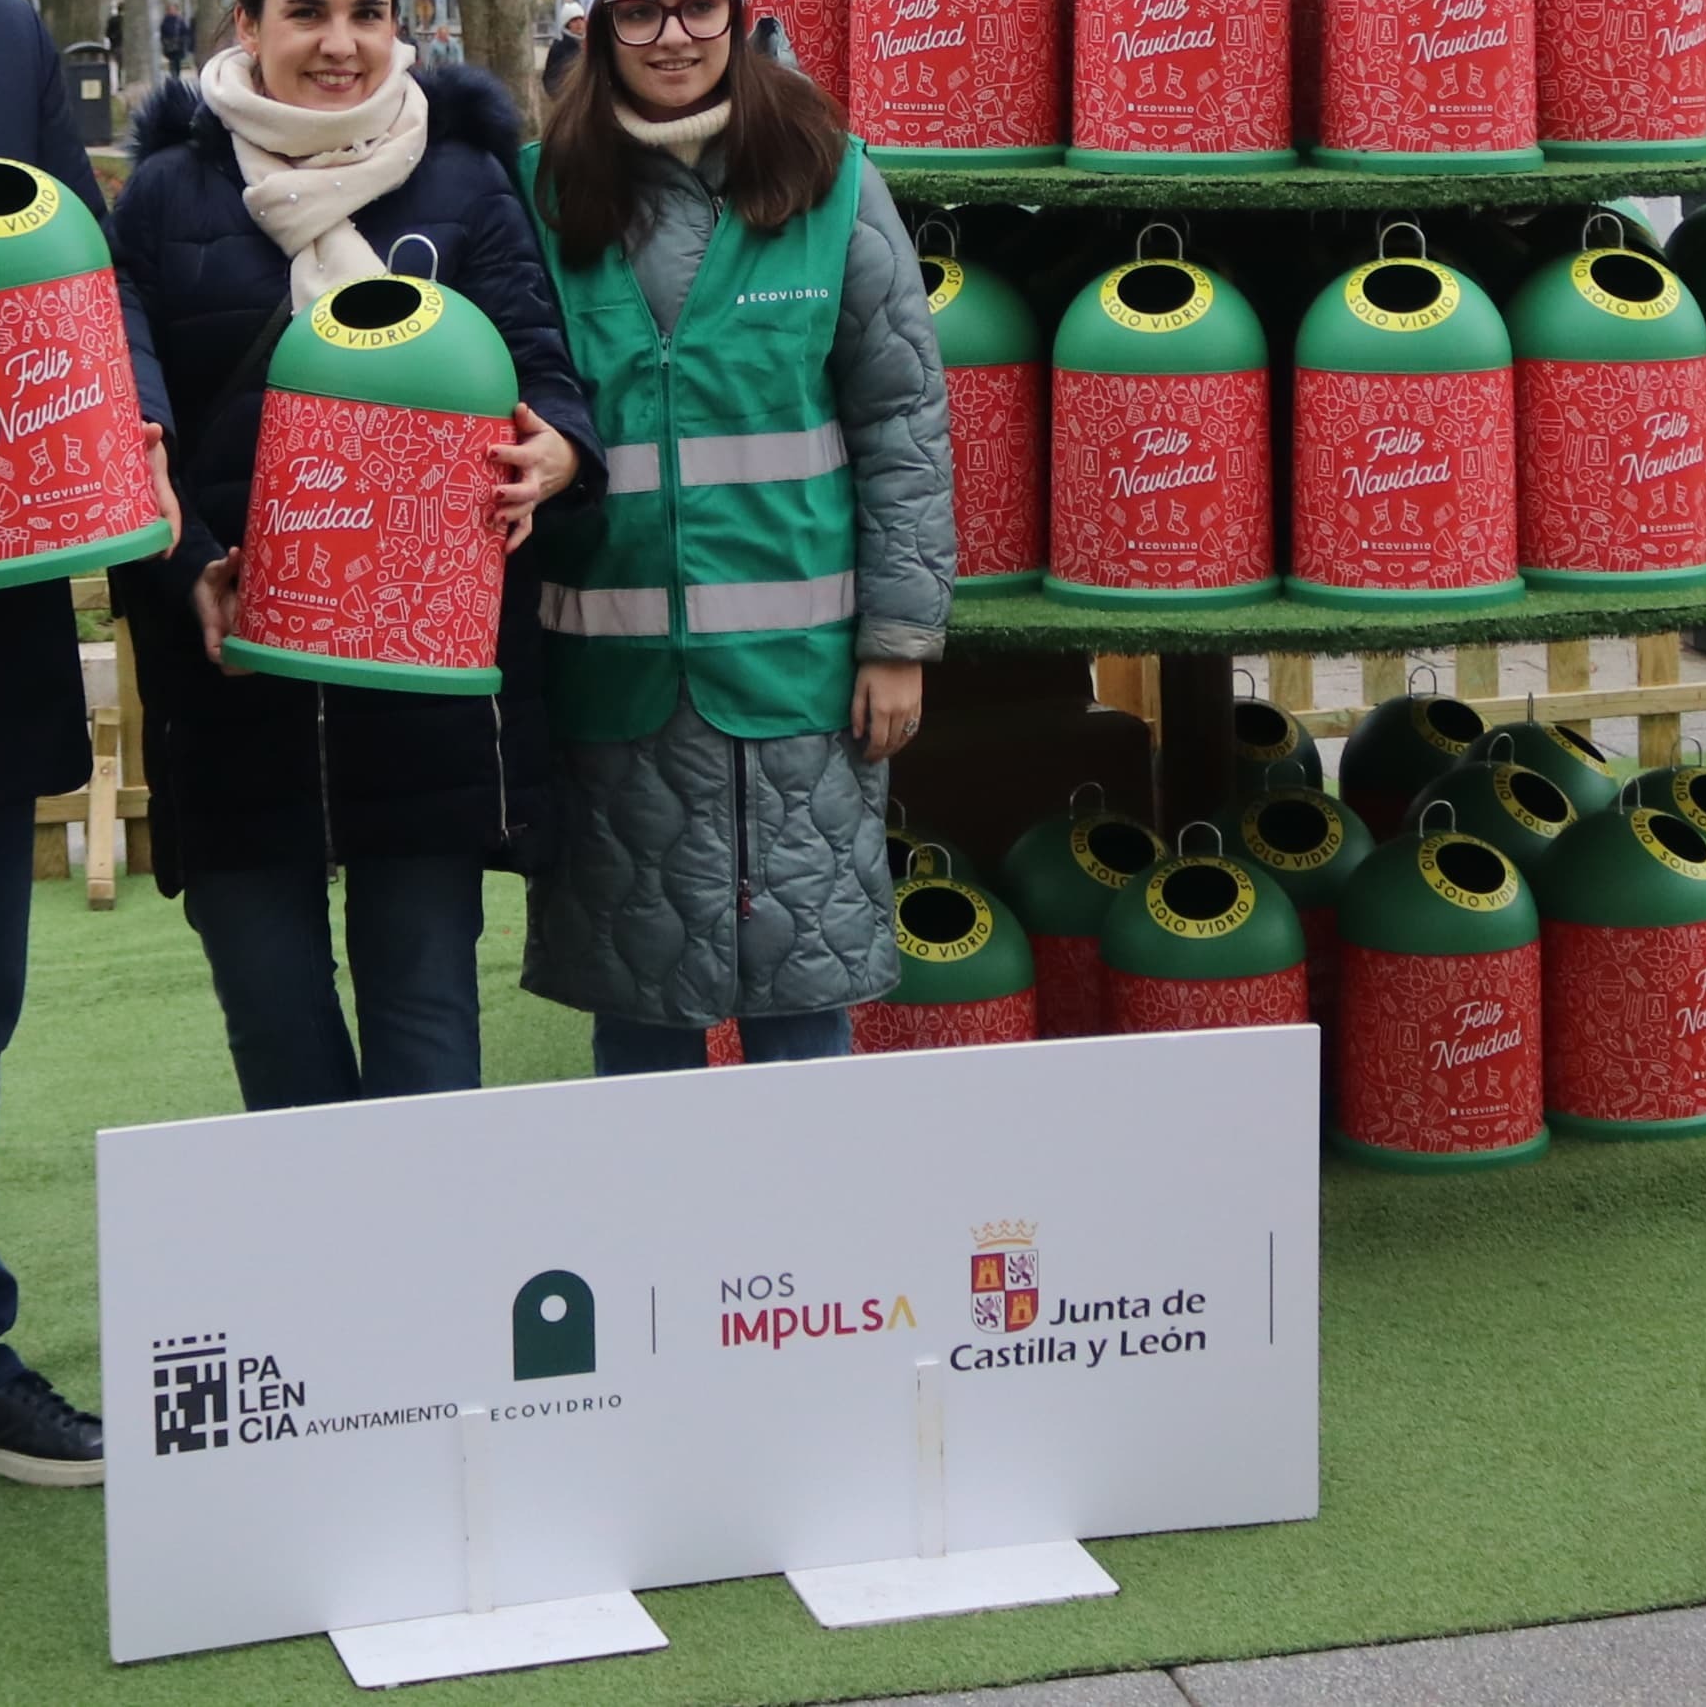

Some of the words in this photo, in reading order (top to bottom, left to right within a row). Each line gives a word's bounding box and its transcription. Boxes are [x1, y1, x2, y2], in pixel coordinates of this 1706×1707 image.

[871, 22, 966, 62] Navidad
[1112, 24, 1215, 64] Navidad
[1408, 23, 1508, 65] Navidad
[892, 102, 946, 112] ECOVIDRIO
[1137, 104, 1194, 114] ECOVIDRIO
[1440, 104, 1494, 114] ECOVIDRIO
[7, 188, 58, 232] VIDRIO
[749, 289, 829, 303] ECOVIDRIO
[1103, 295, 1142, 328] SOLO
[1151, 294, 1207, 329] VIDRIO
[1349, 294, 1389, 327] SOLO
[1398, 296, 1455, 328] VIDRIO
[1583, 285, 1630, 315] SOLO
[1637, 285, 1679, 317] VIDRIO
[347, 319, 422, 347] VIDRIO
[5, 346, 73, 398] Feliz
[1132, 426, 1191, 464] Feliz
[1365, 426, 1425, 462] Feliz
[1643, 411, 1690, 448] Feliz
[287, 456, 348, 495] Feliz
[1108, 456, 1217, 500] Navidad
[1342, 456, 1451, 499] Navidad
[1620, 439, 1703, 486] Navidad
[36, 481, 102, 505] ECOVIDRIO
[263, 498, 374, 537] Navidad
[1650, 523, 1694, 534] ECOVIDRIO
[1138, 541, 1198, 550] ECOVIDRIO
[1372, 542, 1431, 550] ECOVIDRIO
[276, 588, 338, 607] ECOVIDRIO
[1515, 808, 1554, 834] SOLO
[1247, 834, 1285, 866] SOLO
[1293, 834, 1340, 867] VIDRIO
[1660, 850, 1700, 876] SOLO
[1434, 877, 1480, 909] SOLO
[1150, 898, 1186, 933] SOLO
[1195, 900, 1250, 934] VIDRIO
[939, 922, 989, 958] VIDRIO
[1453, 1000, 1505, 1033] Feliz
[1430, 1025, 1522, 1071] Navidad
[1459, 1103, 1510, 1116] ECOVIDRIO
[721, 1272, 795, 1304] NOS
[721, 1296, 917, 1350] IMPULSA
[1049, 1296, 1151, 1326] Junta
[1161, 1289, 1205, 1316] de
[949, 1336, 1076, 1372] Castilla
[1085, 1334, 1107, 1367] y
[1119, 1326, 1207, 1358] León
[238, 1355, 281, 1384] PA
[239, 1381, 305, 1415] LEN
[491, 1394, 623, 1422] ECOVIDRIO
[239, 1413, 298, 1444] CIA
[305, 1402, 459, 1437] AYUNTAMIENTO
